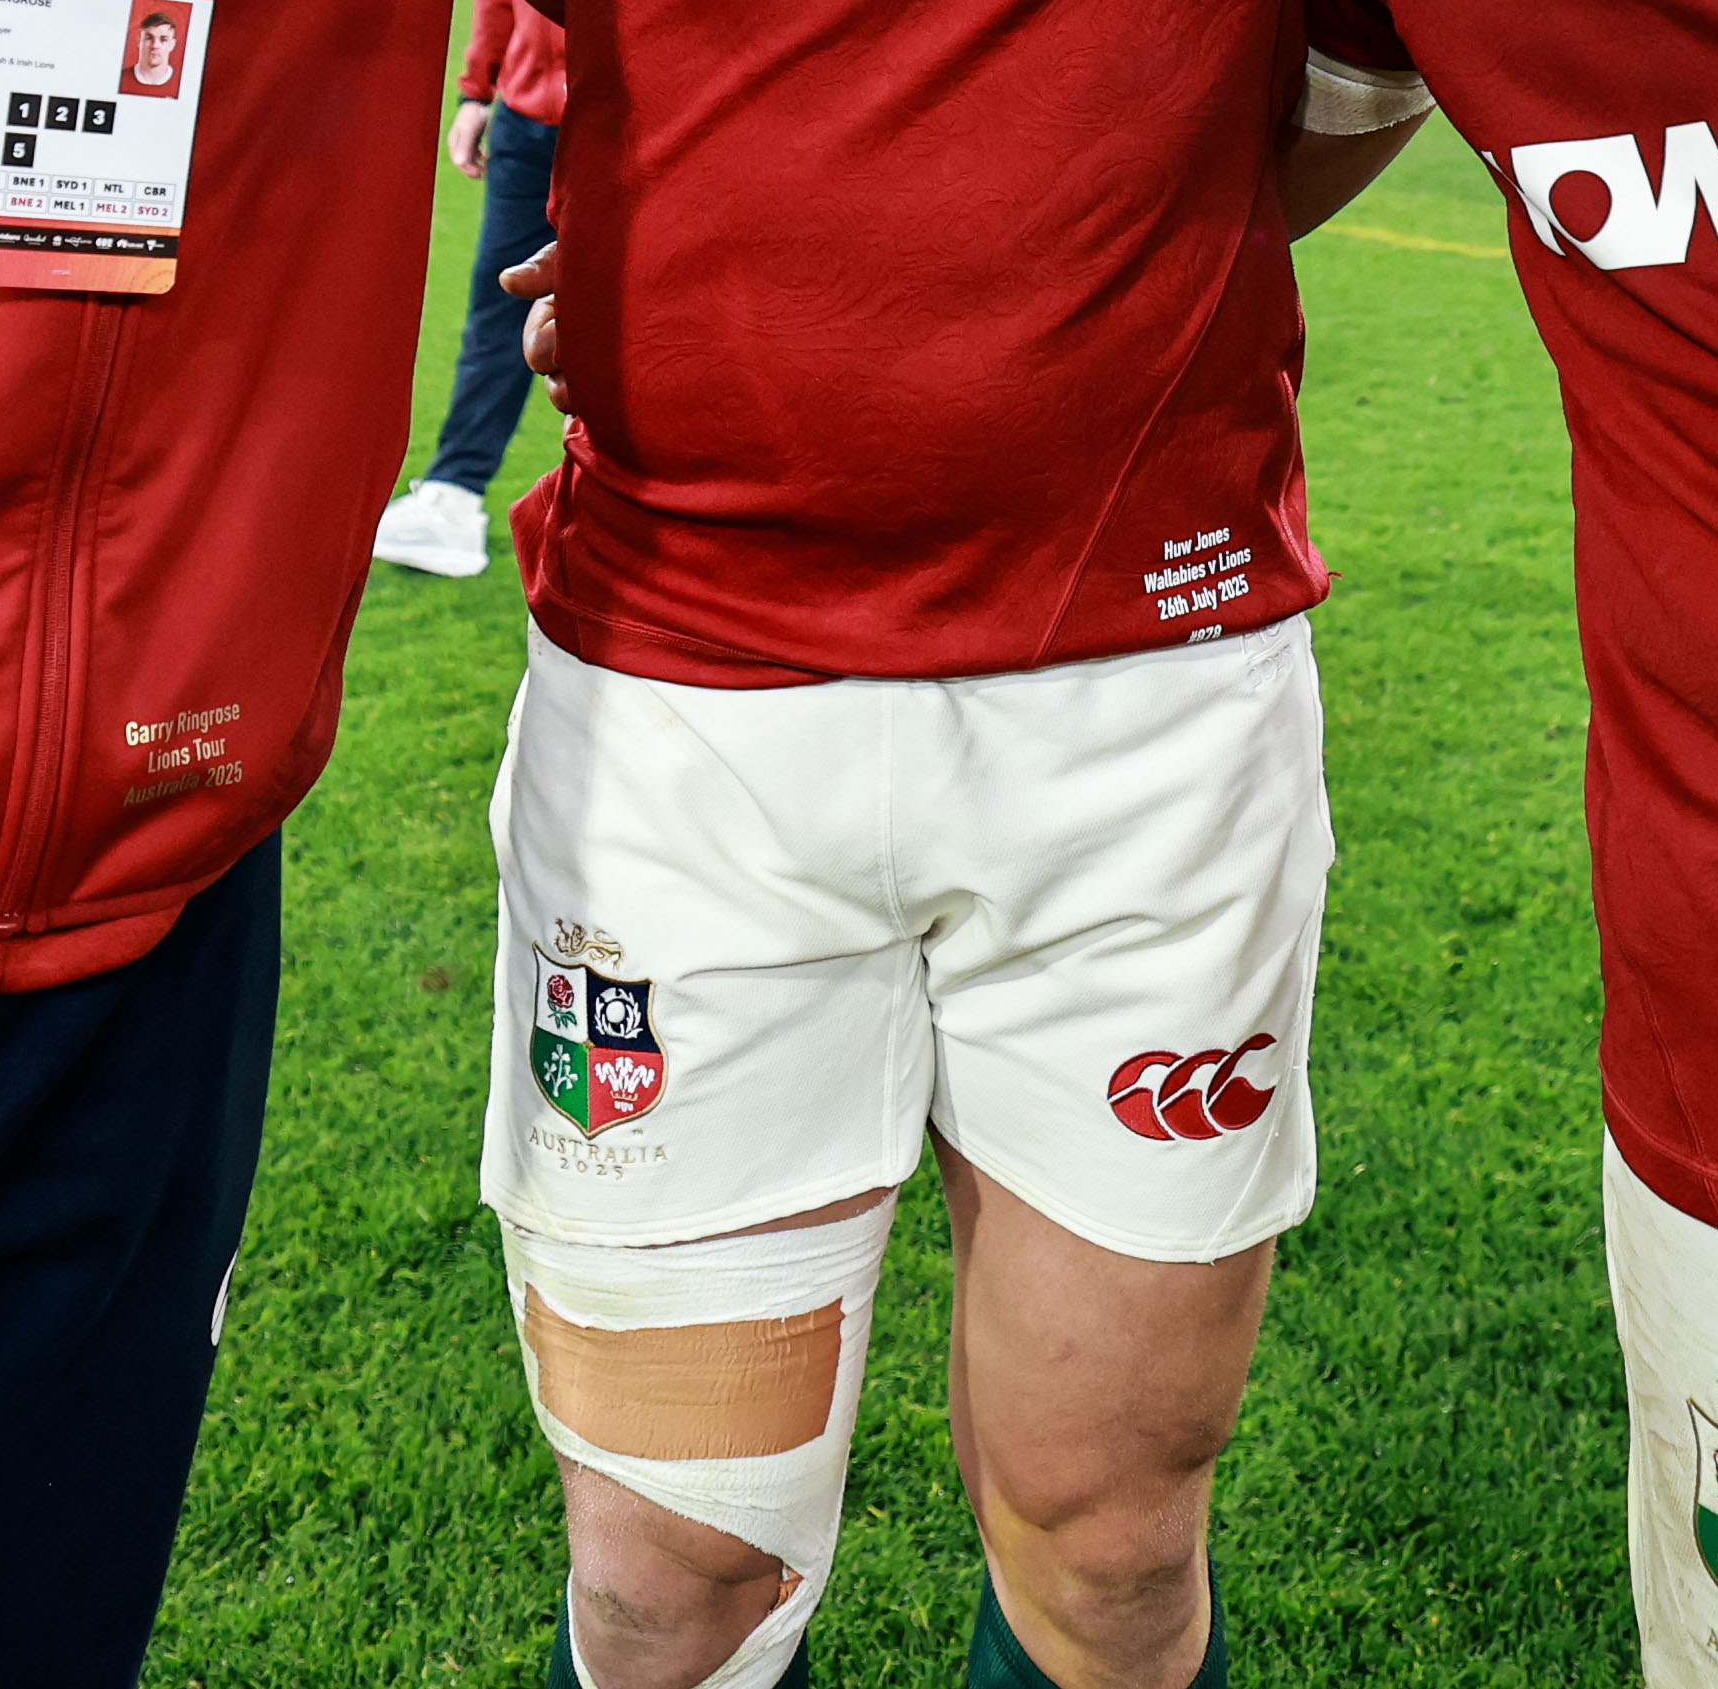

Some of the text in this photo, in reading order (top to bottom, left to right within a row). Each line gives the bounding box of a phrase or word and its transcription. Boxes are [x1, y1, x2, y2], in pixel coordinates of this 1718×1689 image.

[16, 58, 33, 67] Irish
[34, 61, 55, 70] Lions
[19, 103, 106, 126] 1 2 3
[12, 142, 26, 159] 5
[12, 176, 35, 188] BNE
[56, 180, 79, 190] SYD
[103, 184, 124, 194] NTL
[144, 186, 167, 197] CBR
[10, 197, 33, 208] BNE
[53, 200, 77, 211] MEL
[96, 203, 118, 214] MEL
[138, 206, 159, 216] SYD
[1164, 527, 1230, 561] Huw Jones
[1143, 548, 1251, 593] Wallabies v Lions
[1157, 573, 1250, 620] 26th July 2025
[125, 703, 240, 746] Garry Ringrose
[148, 738, 226, 773] Lions Tour
[123, 761, 243, 807] Australia 2025
[529, 1127, 668, 1162] AUSTRALIA
[560, 1157, 624, 1180] 2025
